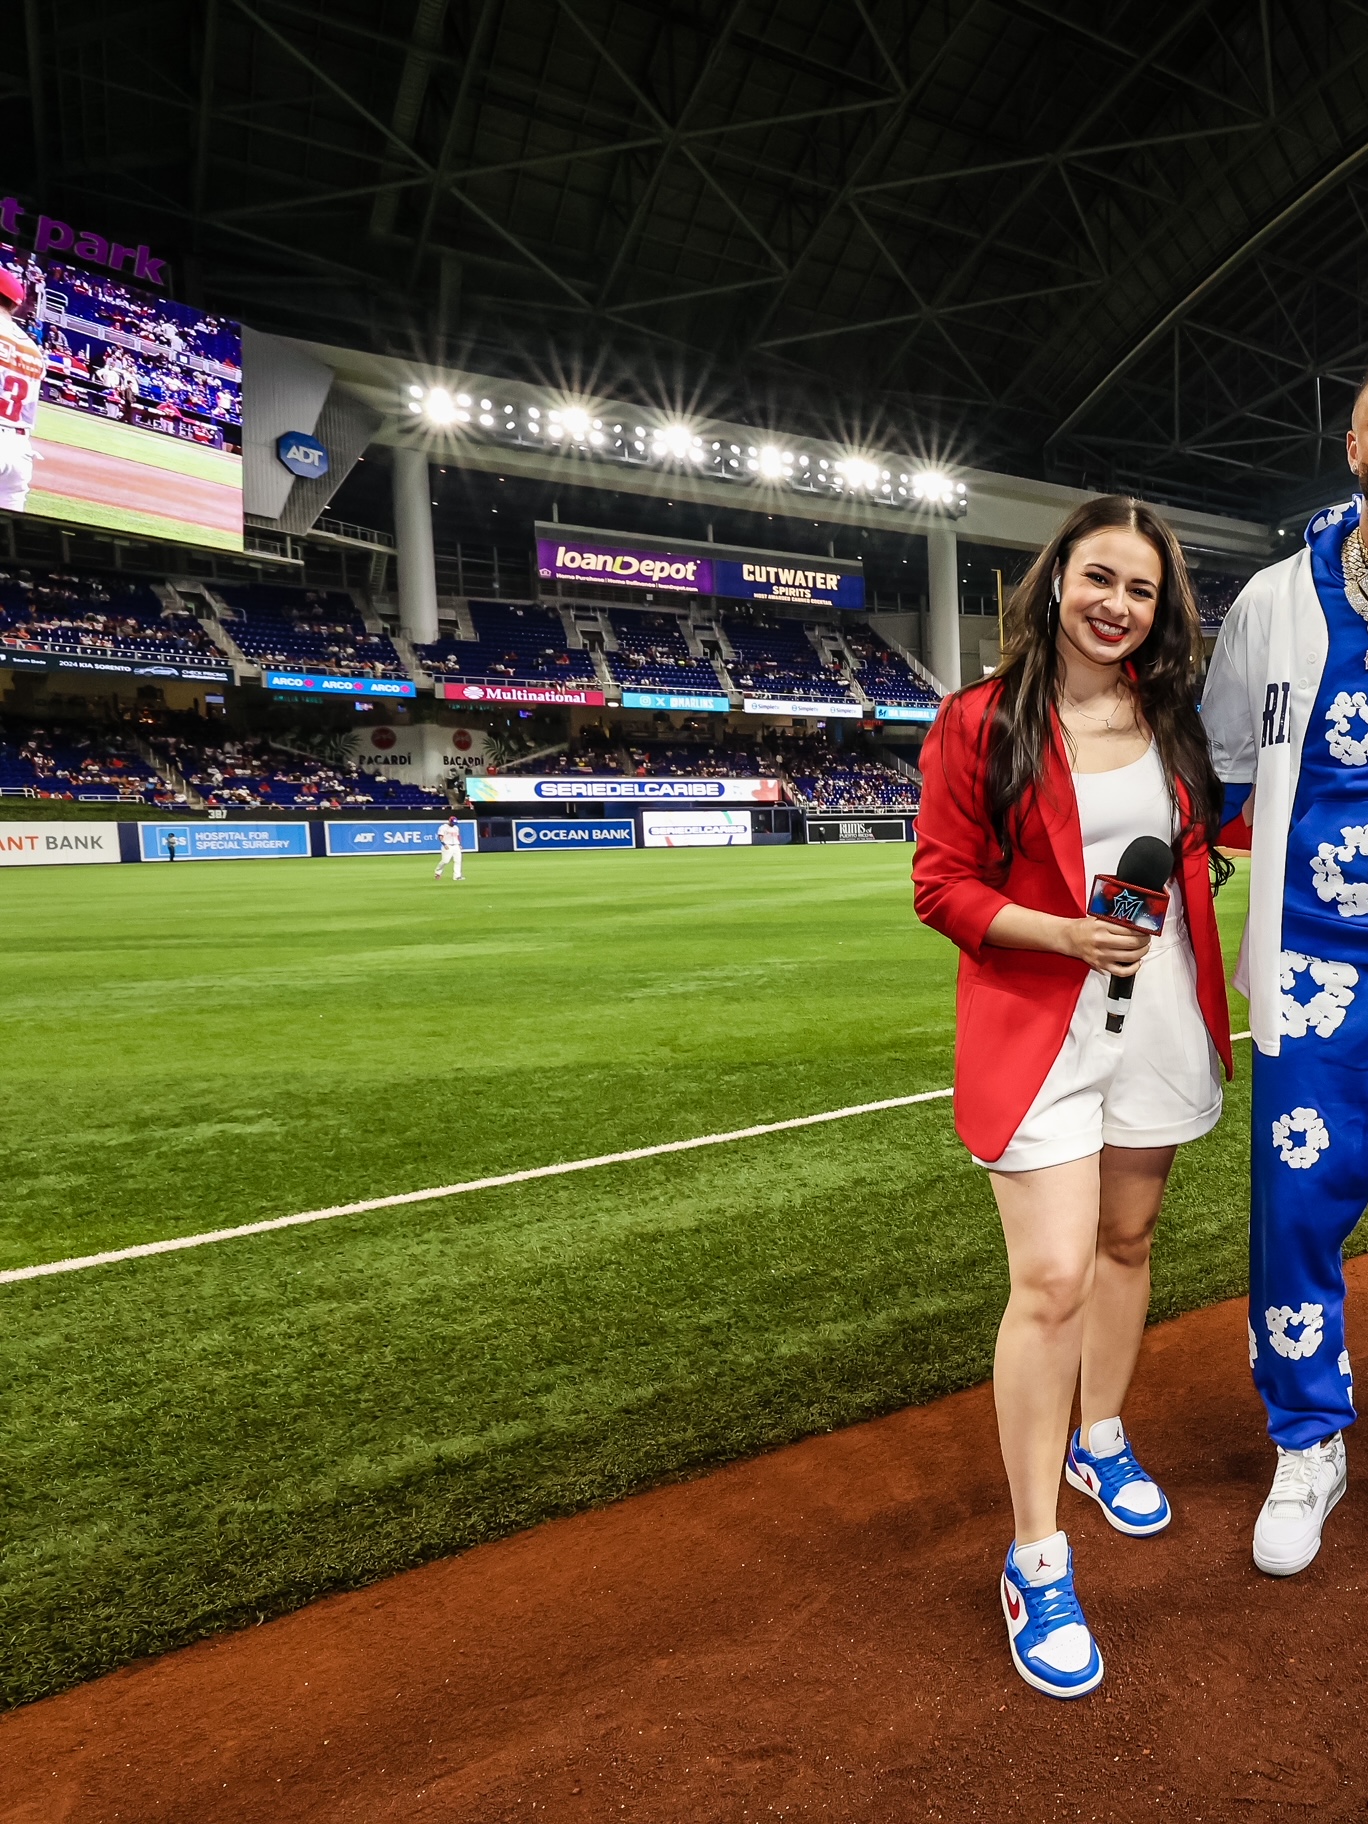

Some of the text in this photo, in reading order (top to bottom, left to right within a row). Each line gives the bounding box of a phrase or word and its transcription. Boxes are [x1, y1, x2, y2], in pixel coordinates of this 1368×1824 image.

[34, 215, 167, 286] park
[286, 445, 324, 467] ADT
[556, 546, 697, 581] loanDepot
[742, 564, 839, 591] CUTWATER
[772, 586, 812, 598] SPIRITS
[59, 660, 79, 668] 2024
[94, 663, 132, 673] SORENTO
[272, 677, 303, 687] ARCO
[322, 680, 353, 690] ARCO
[371, 683, 400, 693] ARCO
[486, 687, 587, 704] Multinational
[359, 752, 412, 765] BACARDÍ
[443, 754, 485, 766] BACARDÍ
[540, 783, 720, 797] SERIEDELCARIBE
[195, 831, 270, 841] HOSPITAL FOR
[354, 832, 376, 843] ADT
[384, 831, 422, 844] SAFE
[539, 828, 631, 841] OCEAN BANK
[45, 835, 104, 850] BANK
[196, 840, 290, 850] SPECIAL SURGERY
